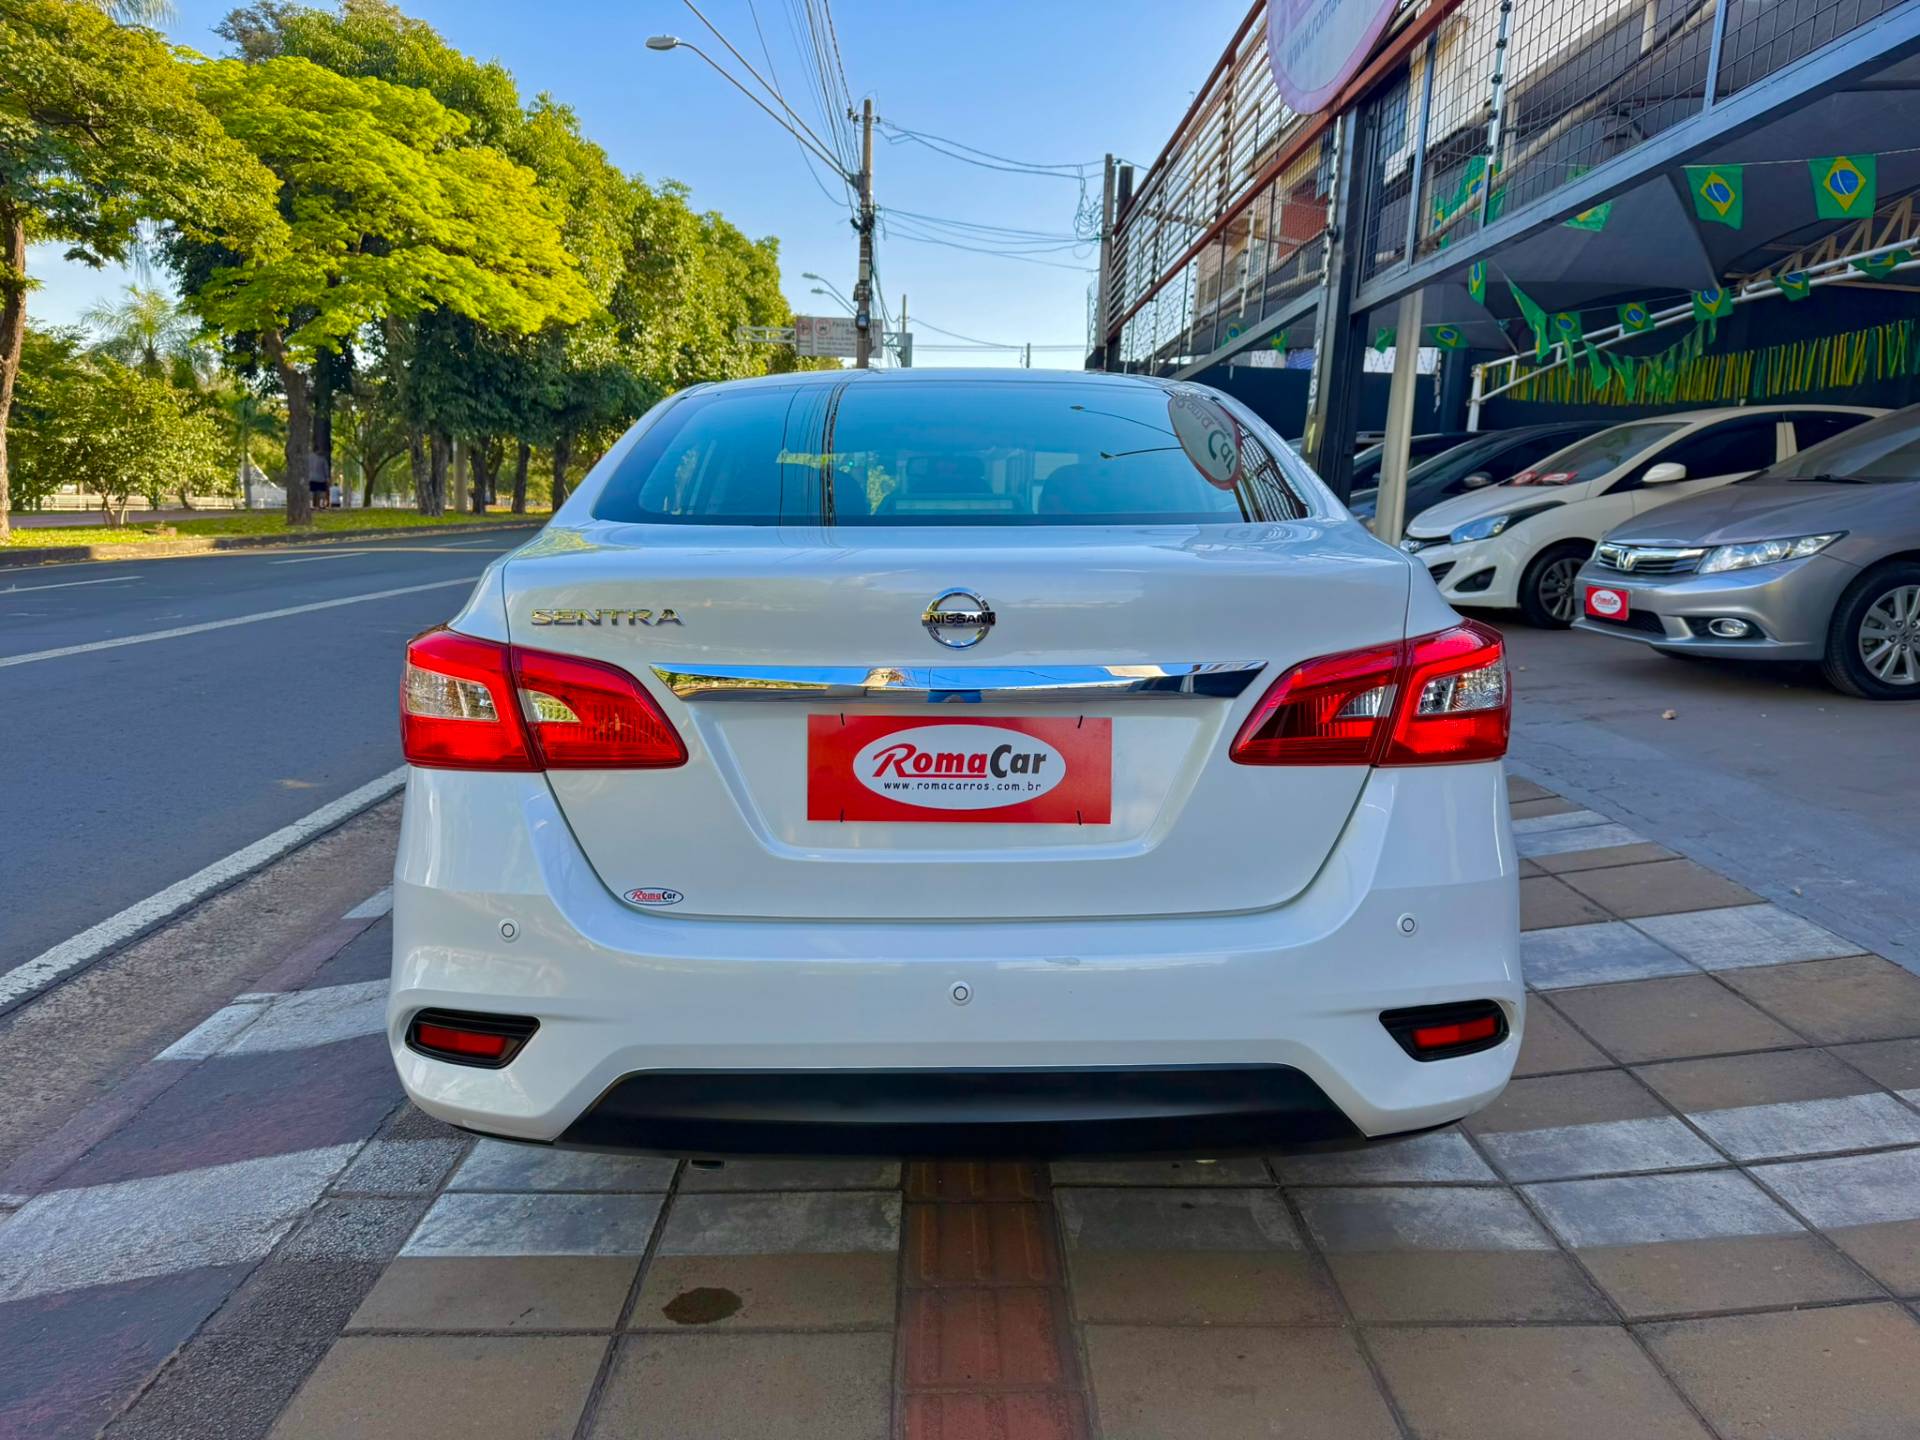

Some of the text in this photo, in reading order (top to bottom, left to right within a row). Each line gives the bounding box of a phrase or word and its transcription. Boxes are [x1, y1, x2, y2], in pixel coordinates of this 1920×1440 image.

[531, 608, 684, 626] SENTRA
[929, 613, 989, 625] NISSAN
[872, 743, 1047, 778] RomaCar
[884, 781, 1042, 792] www.romacarros.com.br
